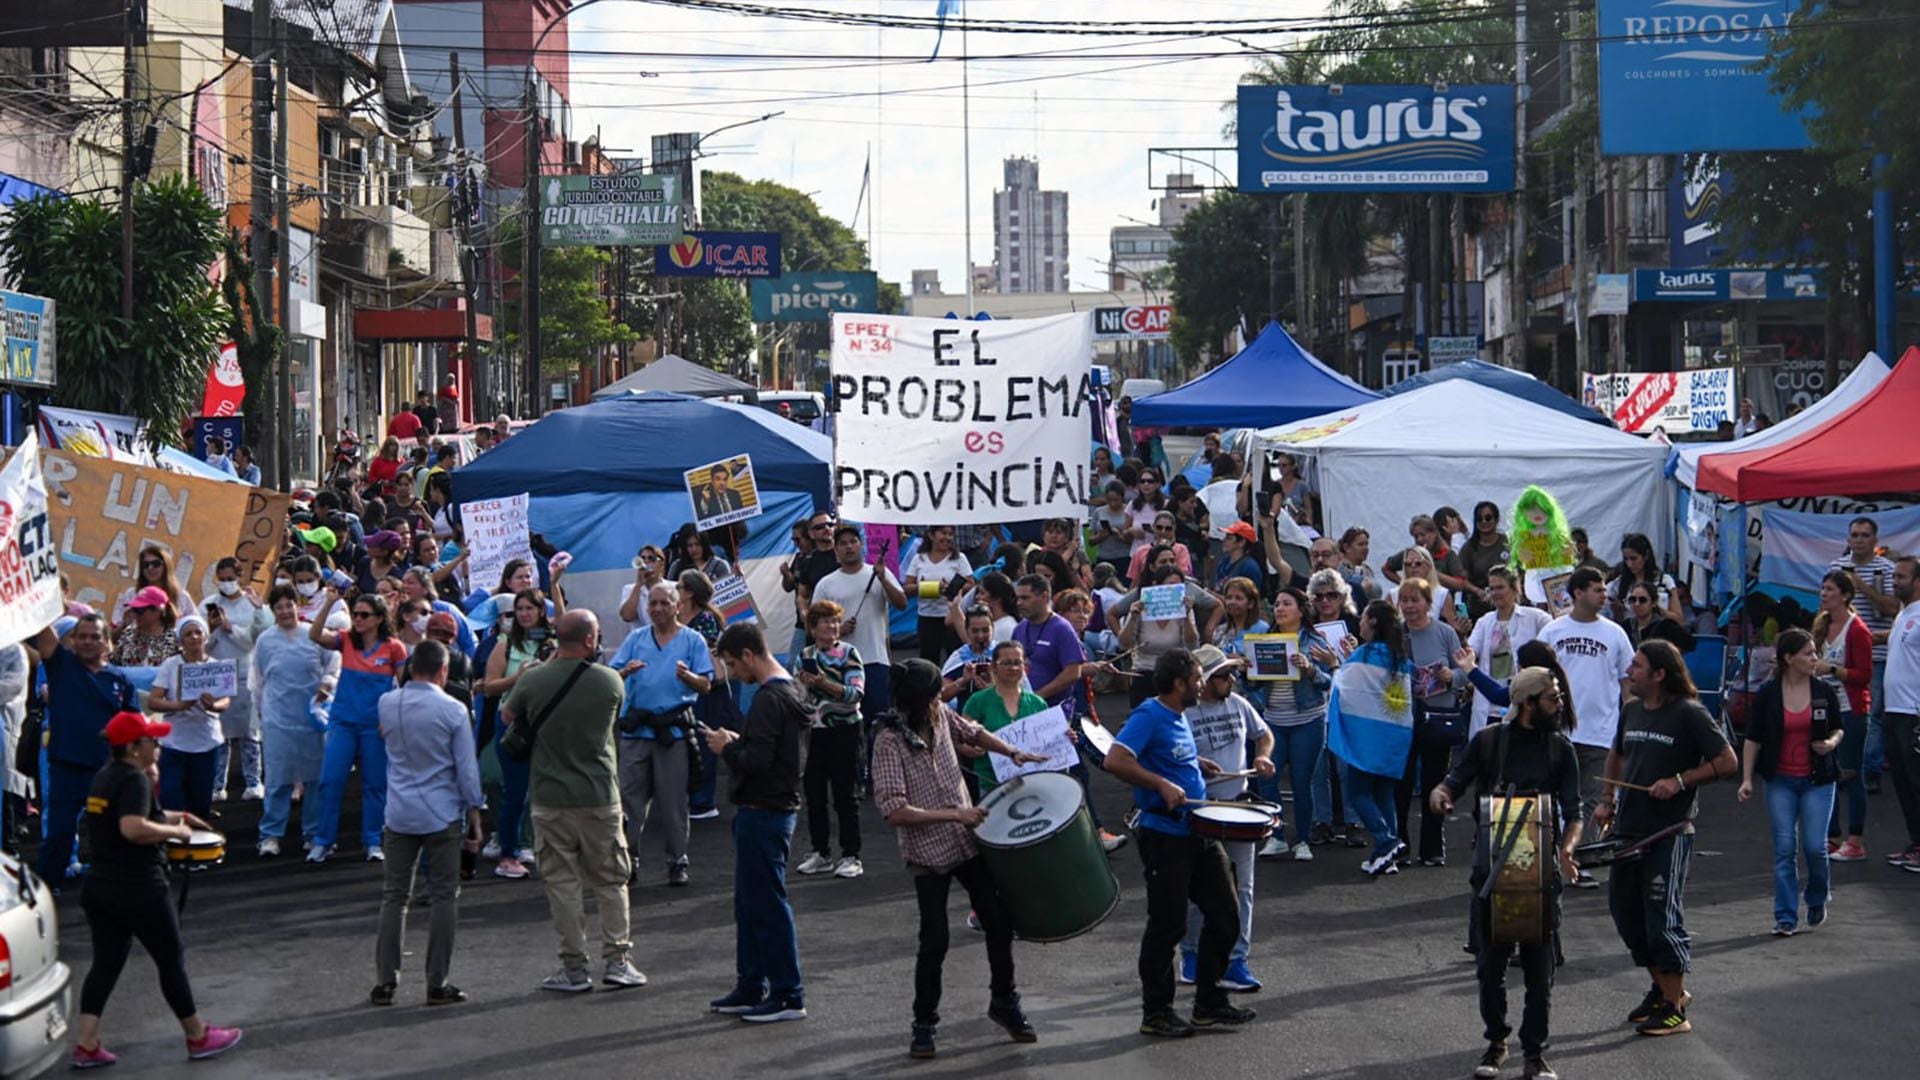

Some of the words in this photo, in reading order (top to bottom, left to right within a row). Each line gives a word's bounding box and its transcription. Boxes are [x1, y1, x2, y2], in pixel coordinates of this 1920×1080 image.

[1625, 70, 1691, 79] COLCHONES
[1276, 90, 1483, 152] taurus
[591, 178, 640, 189] ESTUDIO
[564, 192, 611, 204] JURIDICO
[611, 190, 663, 202] CONTABLE
[670, 238, 769, 268] VICAR
[1659, 270, 1716, 288] taurus
[770, 283, 858, 316] piero
[843, 322, 890, 337] EPET
[932, 329, 997, 366] EL
[1690, 370, 1728, 390] SALARIO
[833, 372, 1092, 423] PROBLEMA
[1691, 391, 1726, 408] BASICO
[964, 431, 1005, 454] es
[103, 472, 189, 536] UN
[1565, 644, 1599, 658] WILD
